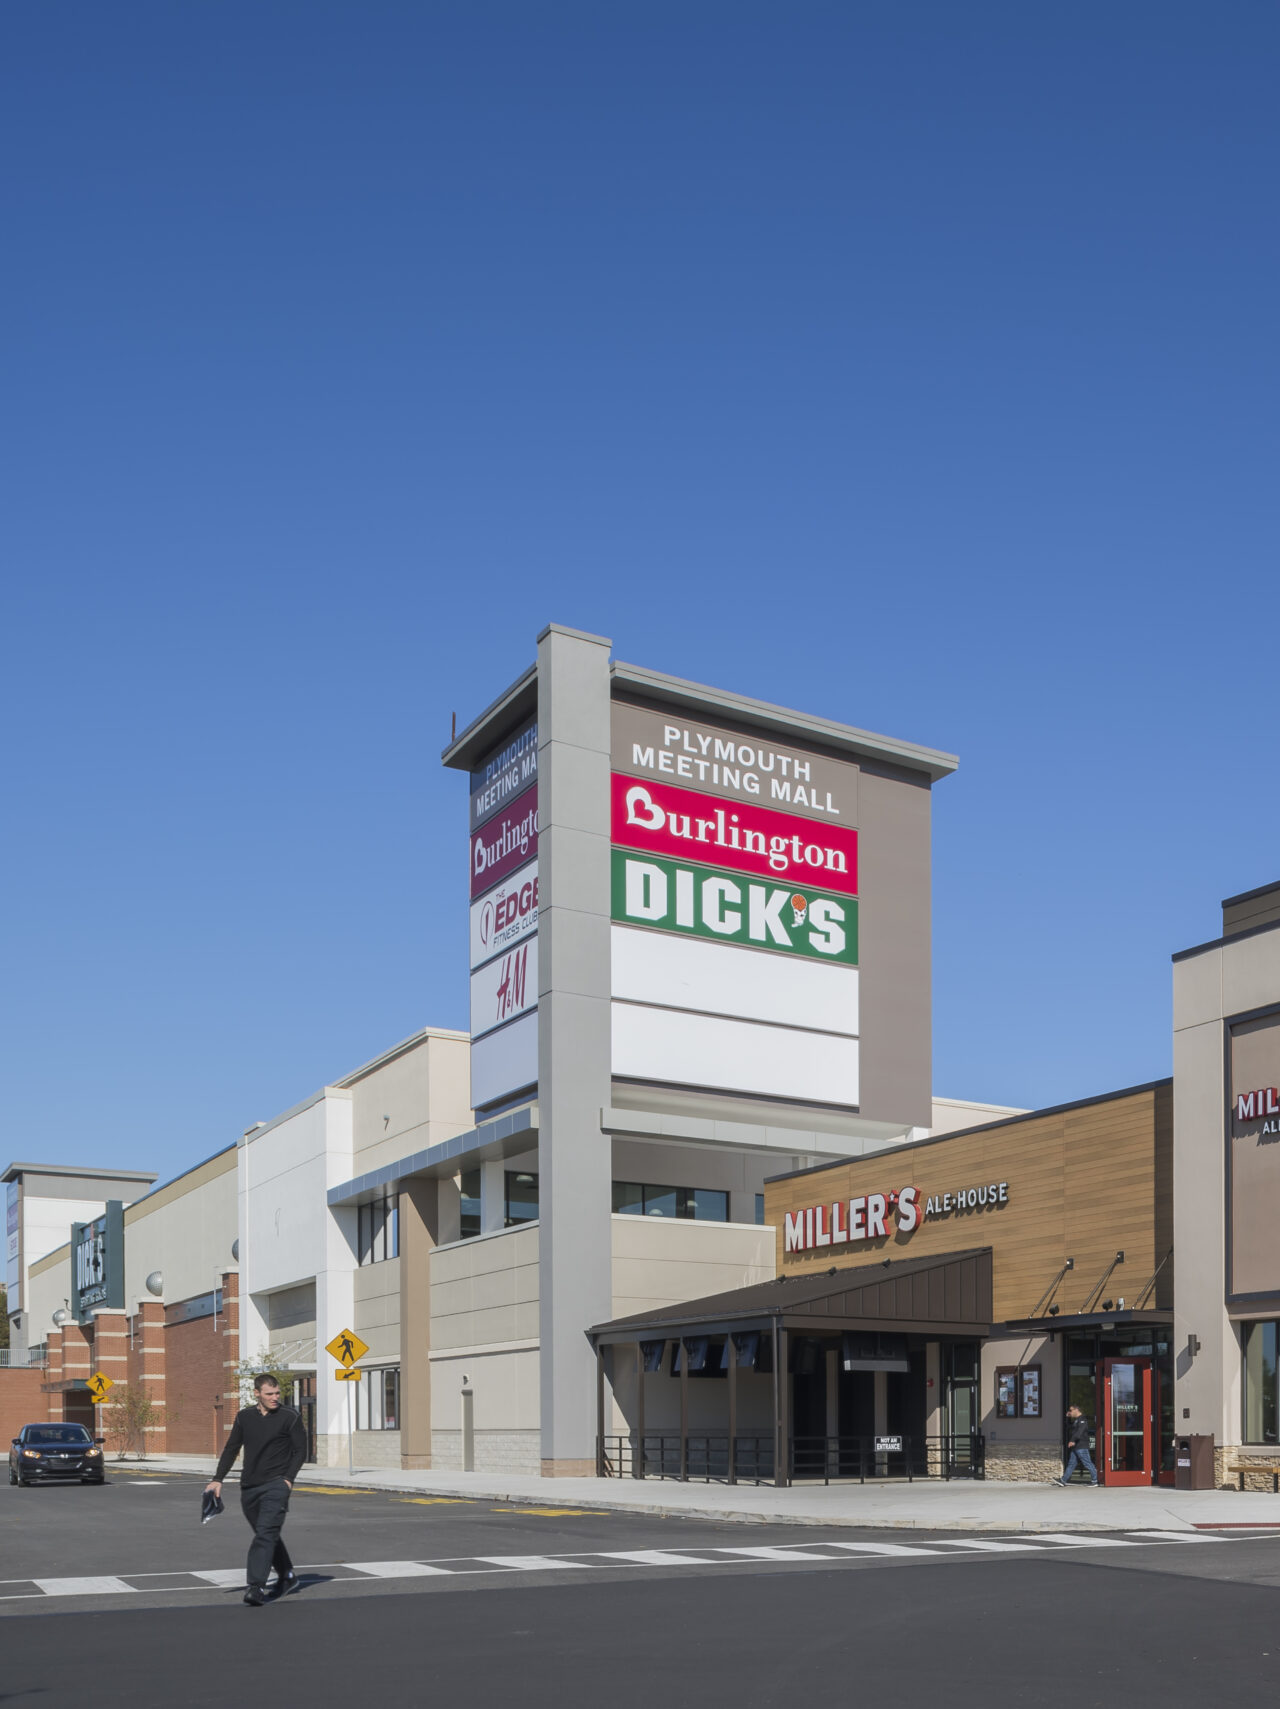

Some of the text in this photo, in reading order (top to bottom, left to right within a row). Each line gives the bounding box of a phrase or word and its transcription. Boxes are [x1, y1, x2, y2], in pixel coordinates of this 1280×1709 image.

[486, 723, 537, 785] PLYMOUTH
[633, 743, 840, 815] MEETING MALL
[664, 725, 811, 782] PLYMOUTH
[476, 766, 519, 818] MEETING
[625, 786, 849, 872] Burlington
[496, 889, 506, 899] THE
[625, 859, 847, 956] DICK'S
[493, 922, 520, 949] FITNESS
[496, 943, 528, 1021] H&M
[785, 1186, 922, 1254] MILLER'S
